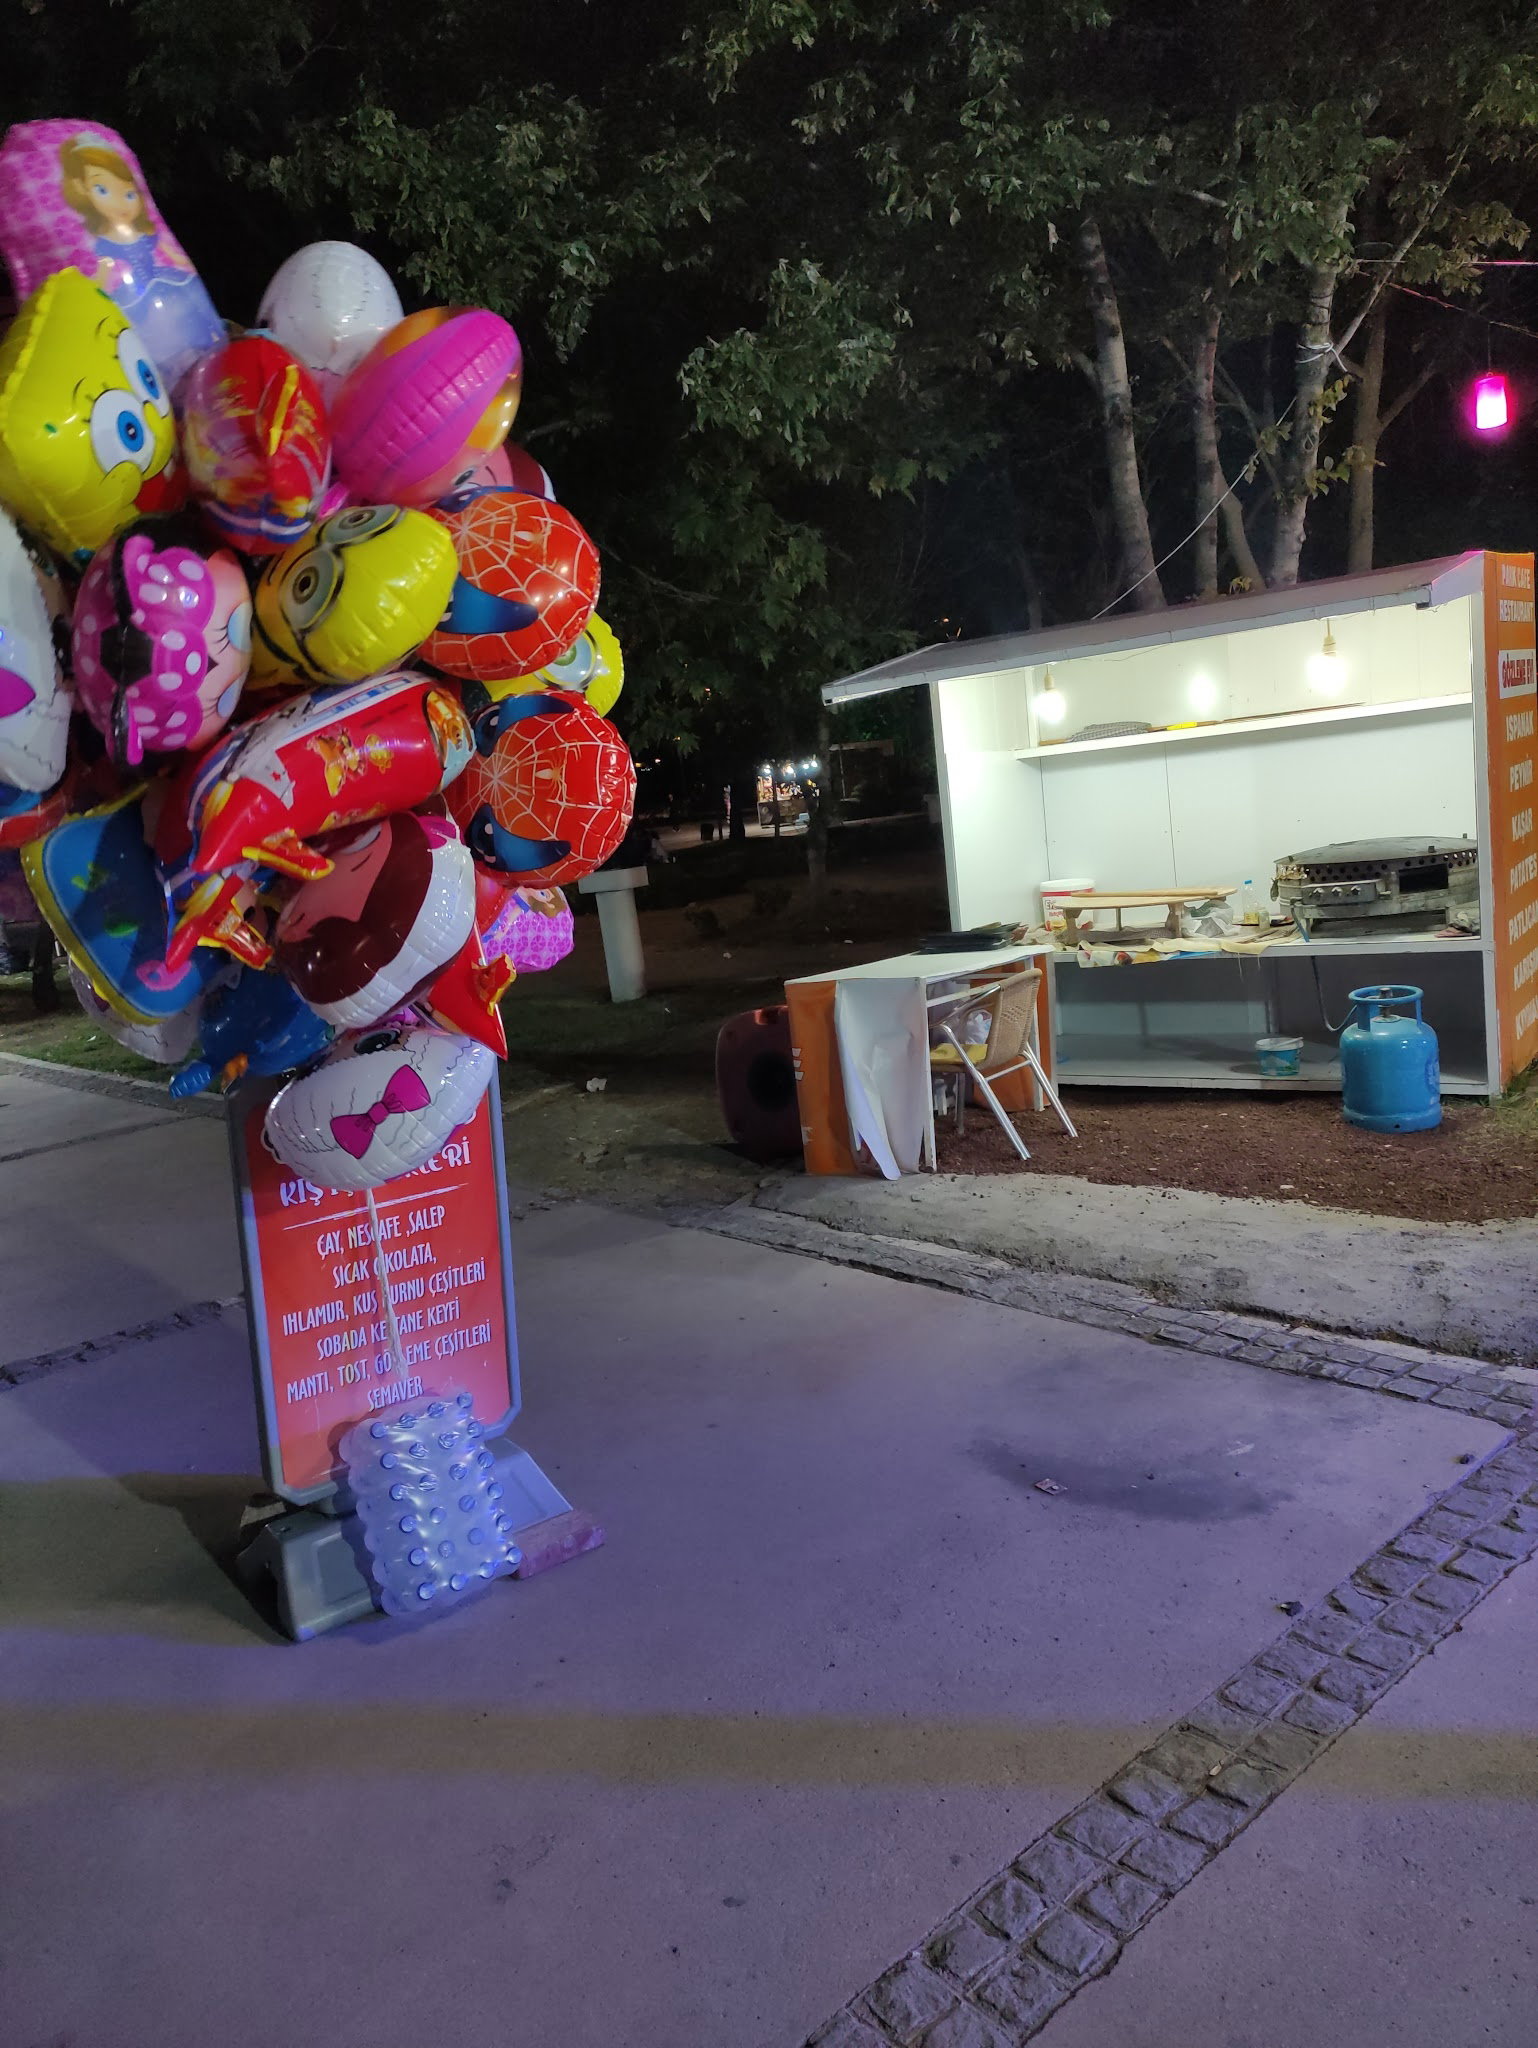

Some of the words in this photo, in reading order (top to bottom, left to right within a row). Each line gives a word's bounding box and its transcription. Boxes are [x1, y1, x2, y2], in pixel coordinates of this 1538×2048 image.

[1499, 599, 1534, 622] RESTAURANT
[1506, 711, 1534, 742] ISPANAK
[1510, 753, 1533, 792] PEYNİR
[1512, 808, 1533, 844] KAŞAR
[1510, 853, 1538, 895] PATATES
[316, 1230, 344, 1260] ÇAY,
[332, 1259, 370, 1289] SICAK
[282, 1300, 349, 1336] IHLAMUR,
[353, 1289, 378, 1314] KUŞ
[382, 1276, 424, 1307] URNU
[428, 1257, 486, 1297] ÇEŞİTLERİ
[316, 1326, 367, 1360] SOBADA
[371, 1310, 424, 1344] KETANE
[427, 1296, 460, 1327] KEYFİ
[287, 1371, 334, 1404] MANTI,
[337, 1358, 371, 1387] TOST,
[434, 1319, 491, 1360] ÇEŞİTLERİ
[366, 1375, 424, 1412] SEMAVER
